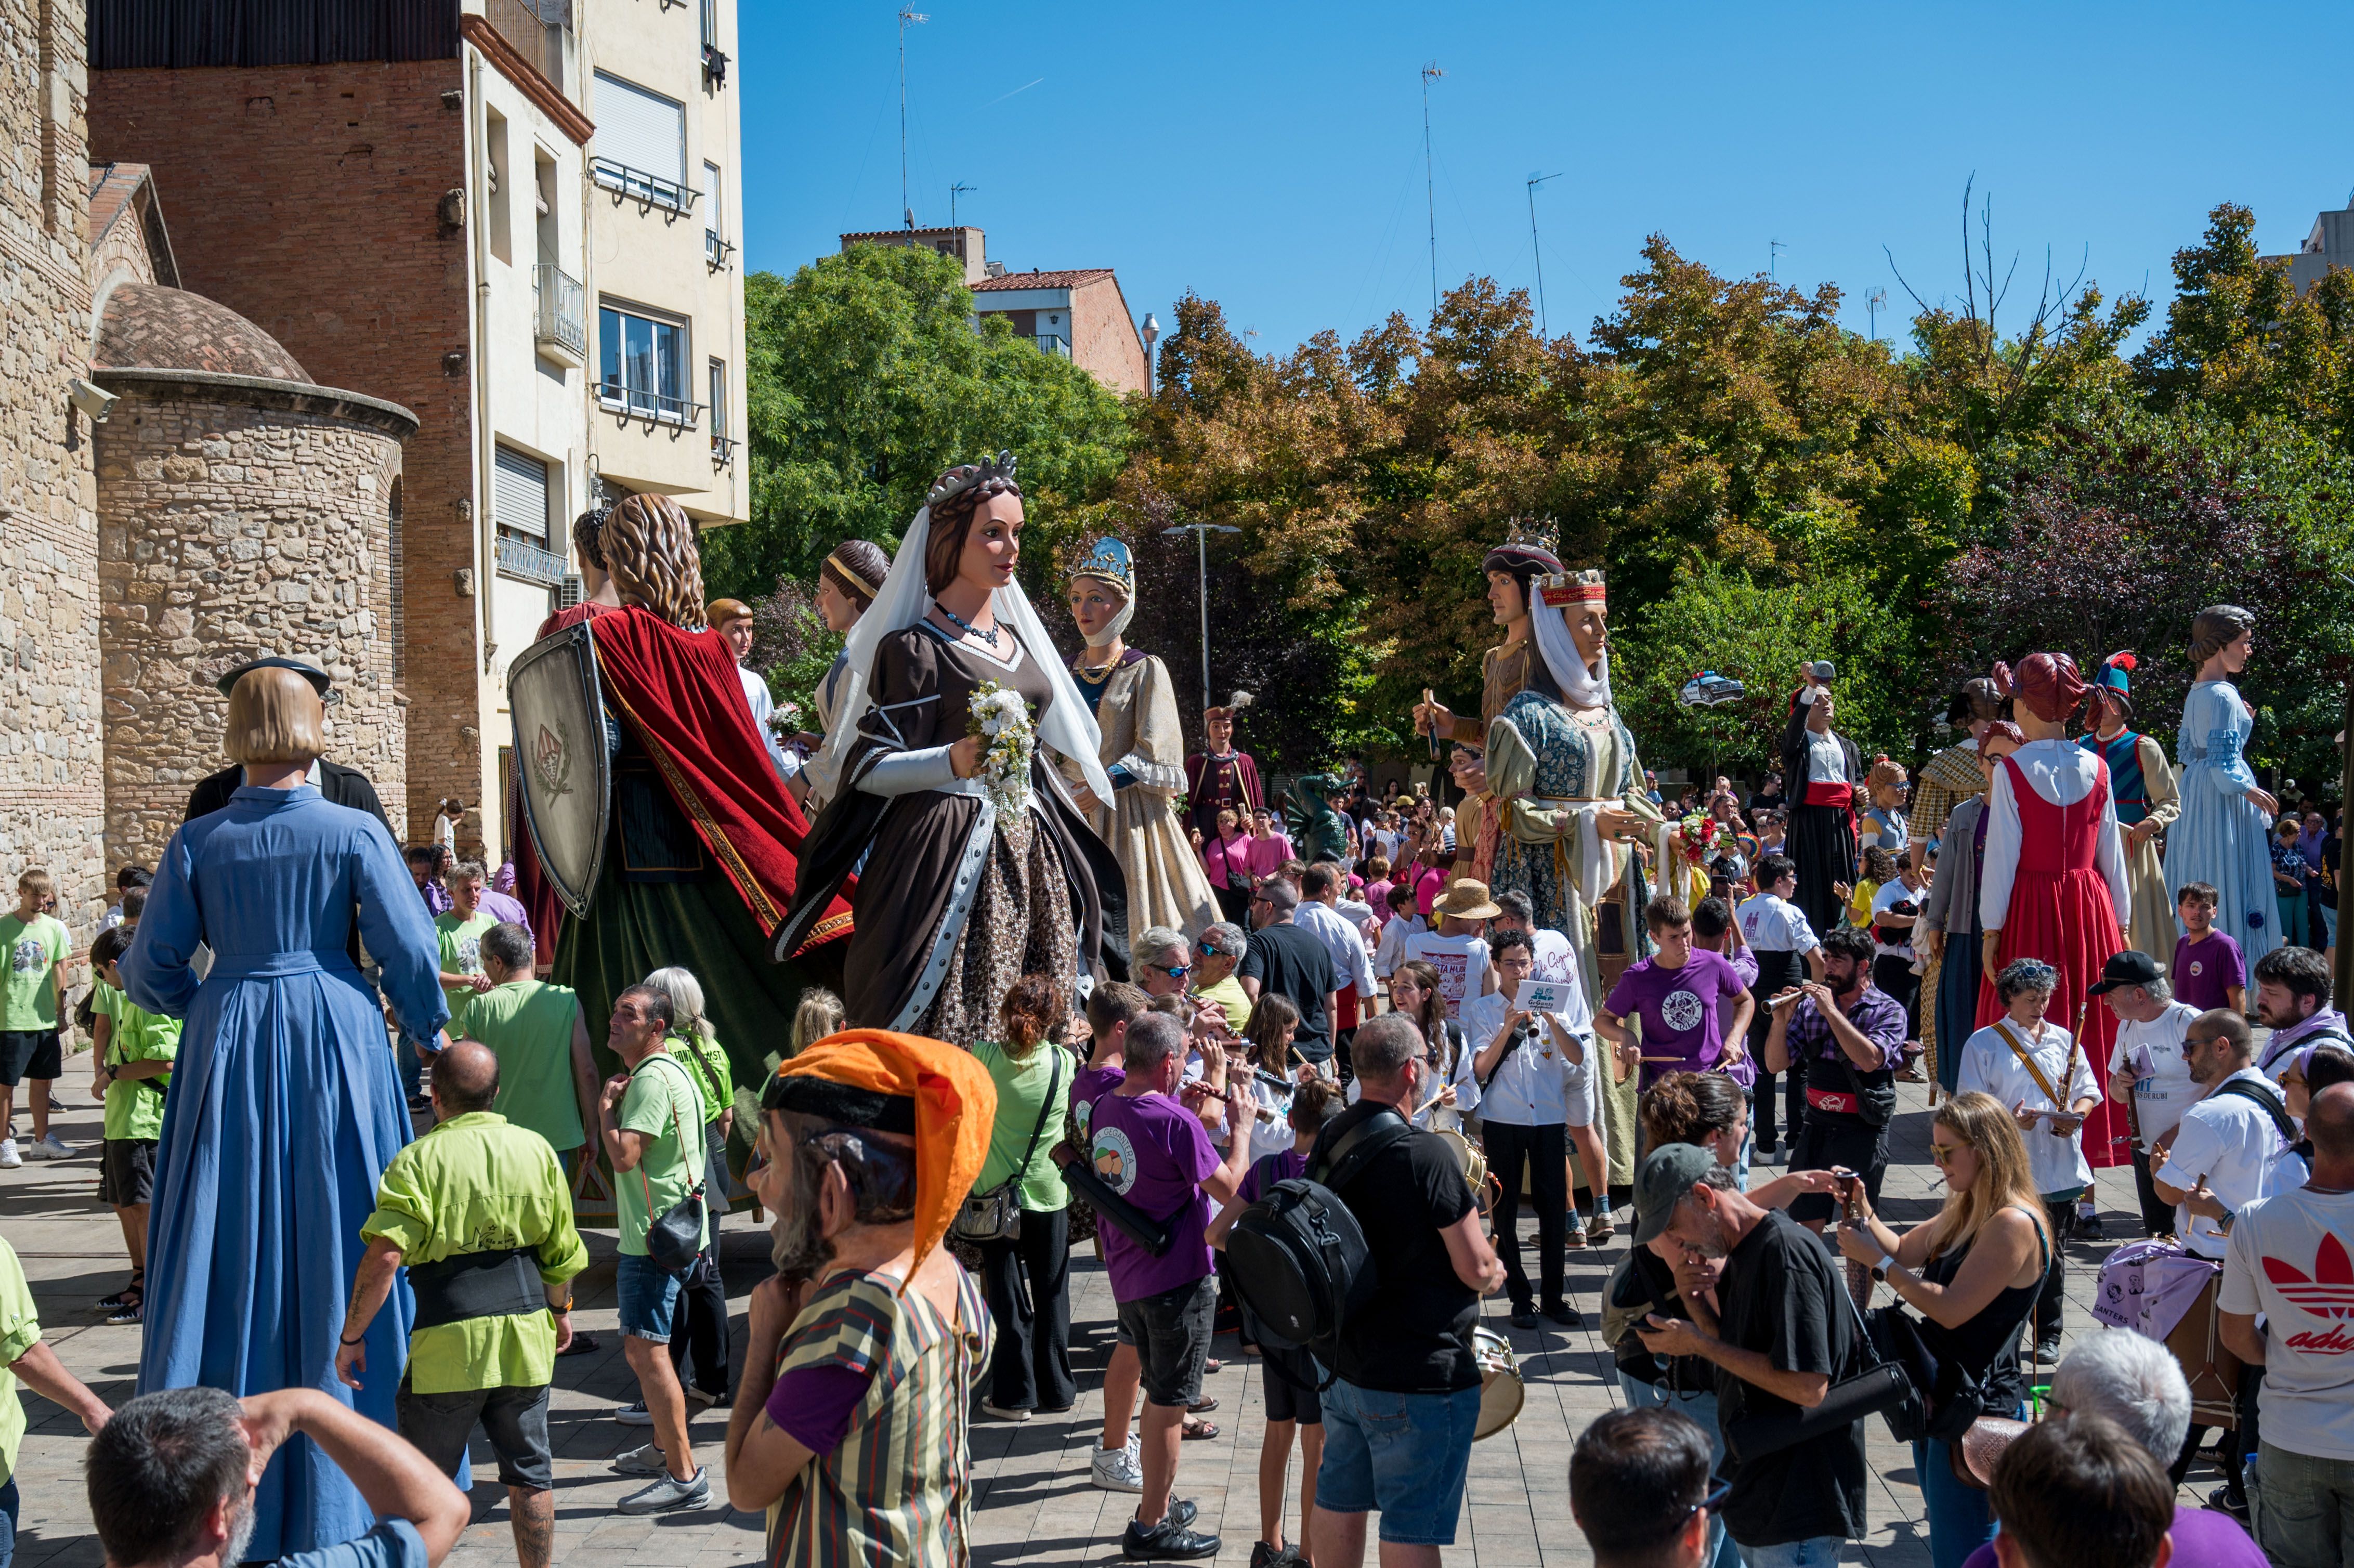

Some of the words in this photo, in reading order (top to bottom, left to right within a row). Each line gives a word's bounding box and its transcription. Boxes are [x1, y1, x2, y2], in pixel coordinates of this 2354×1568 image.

[1432, 963, 1448, 974] STA
[1449, 965, 1466, 974] MAJOR
[1094, 1133, 1101, 1144] LA
[1104, 1128, 1134, 1165] GEGANTERA
